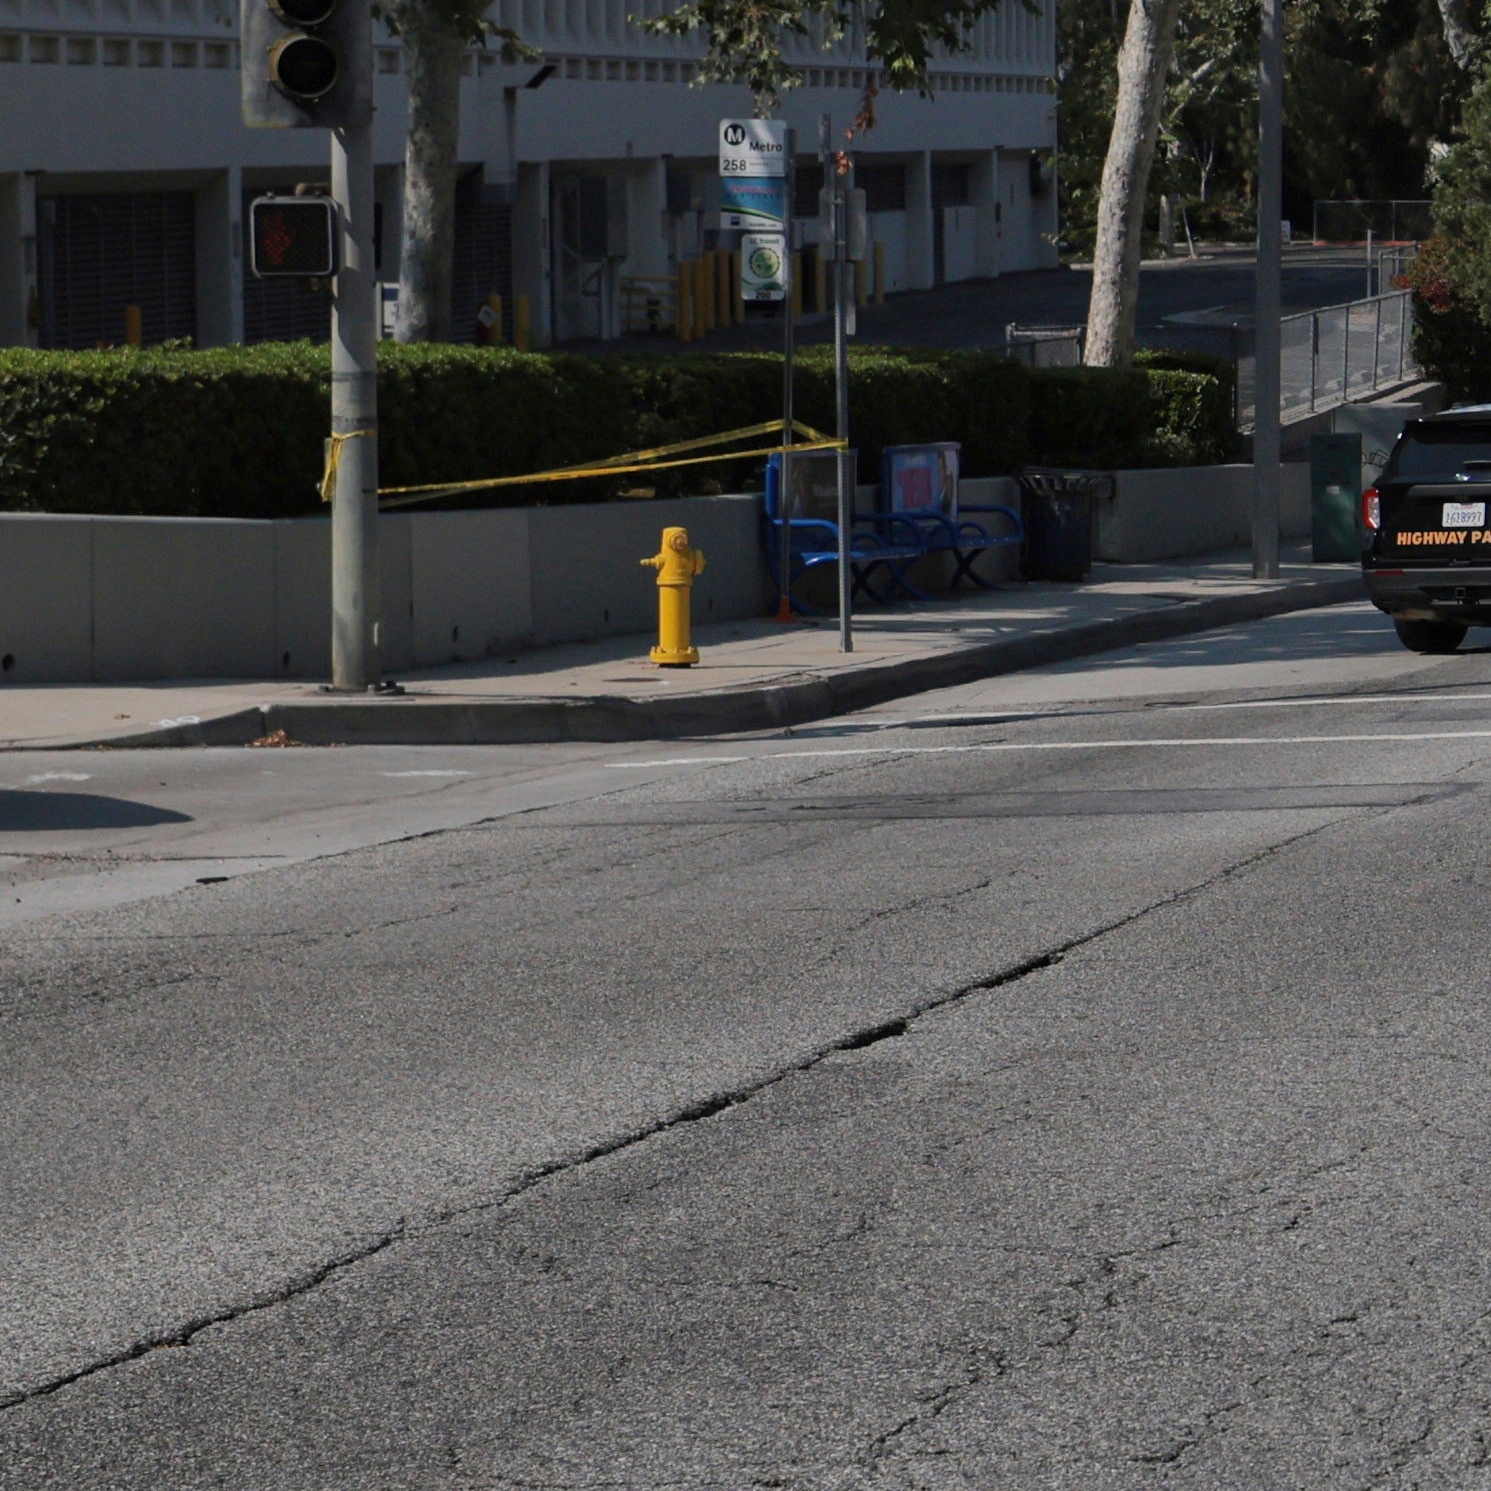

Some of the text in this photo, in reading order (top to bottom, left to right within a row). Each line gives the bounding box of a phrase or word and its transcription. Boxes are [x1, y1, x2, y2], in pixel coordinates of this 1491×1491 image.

[725, 125, 745, 144] M
[750, 141, 783, 152] Metro
[723, 158, 747, 171] 258
[1396, 530, 1468, 546] HIGHWAY
